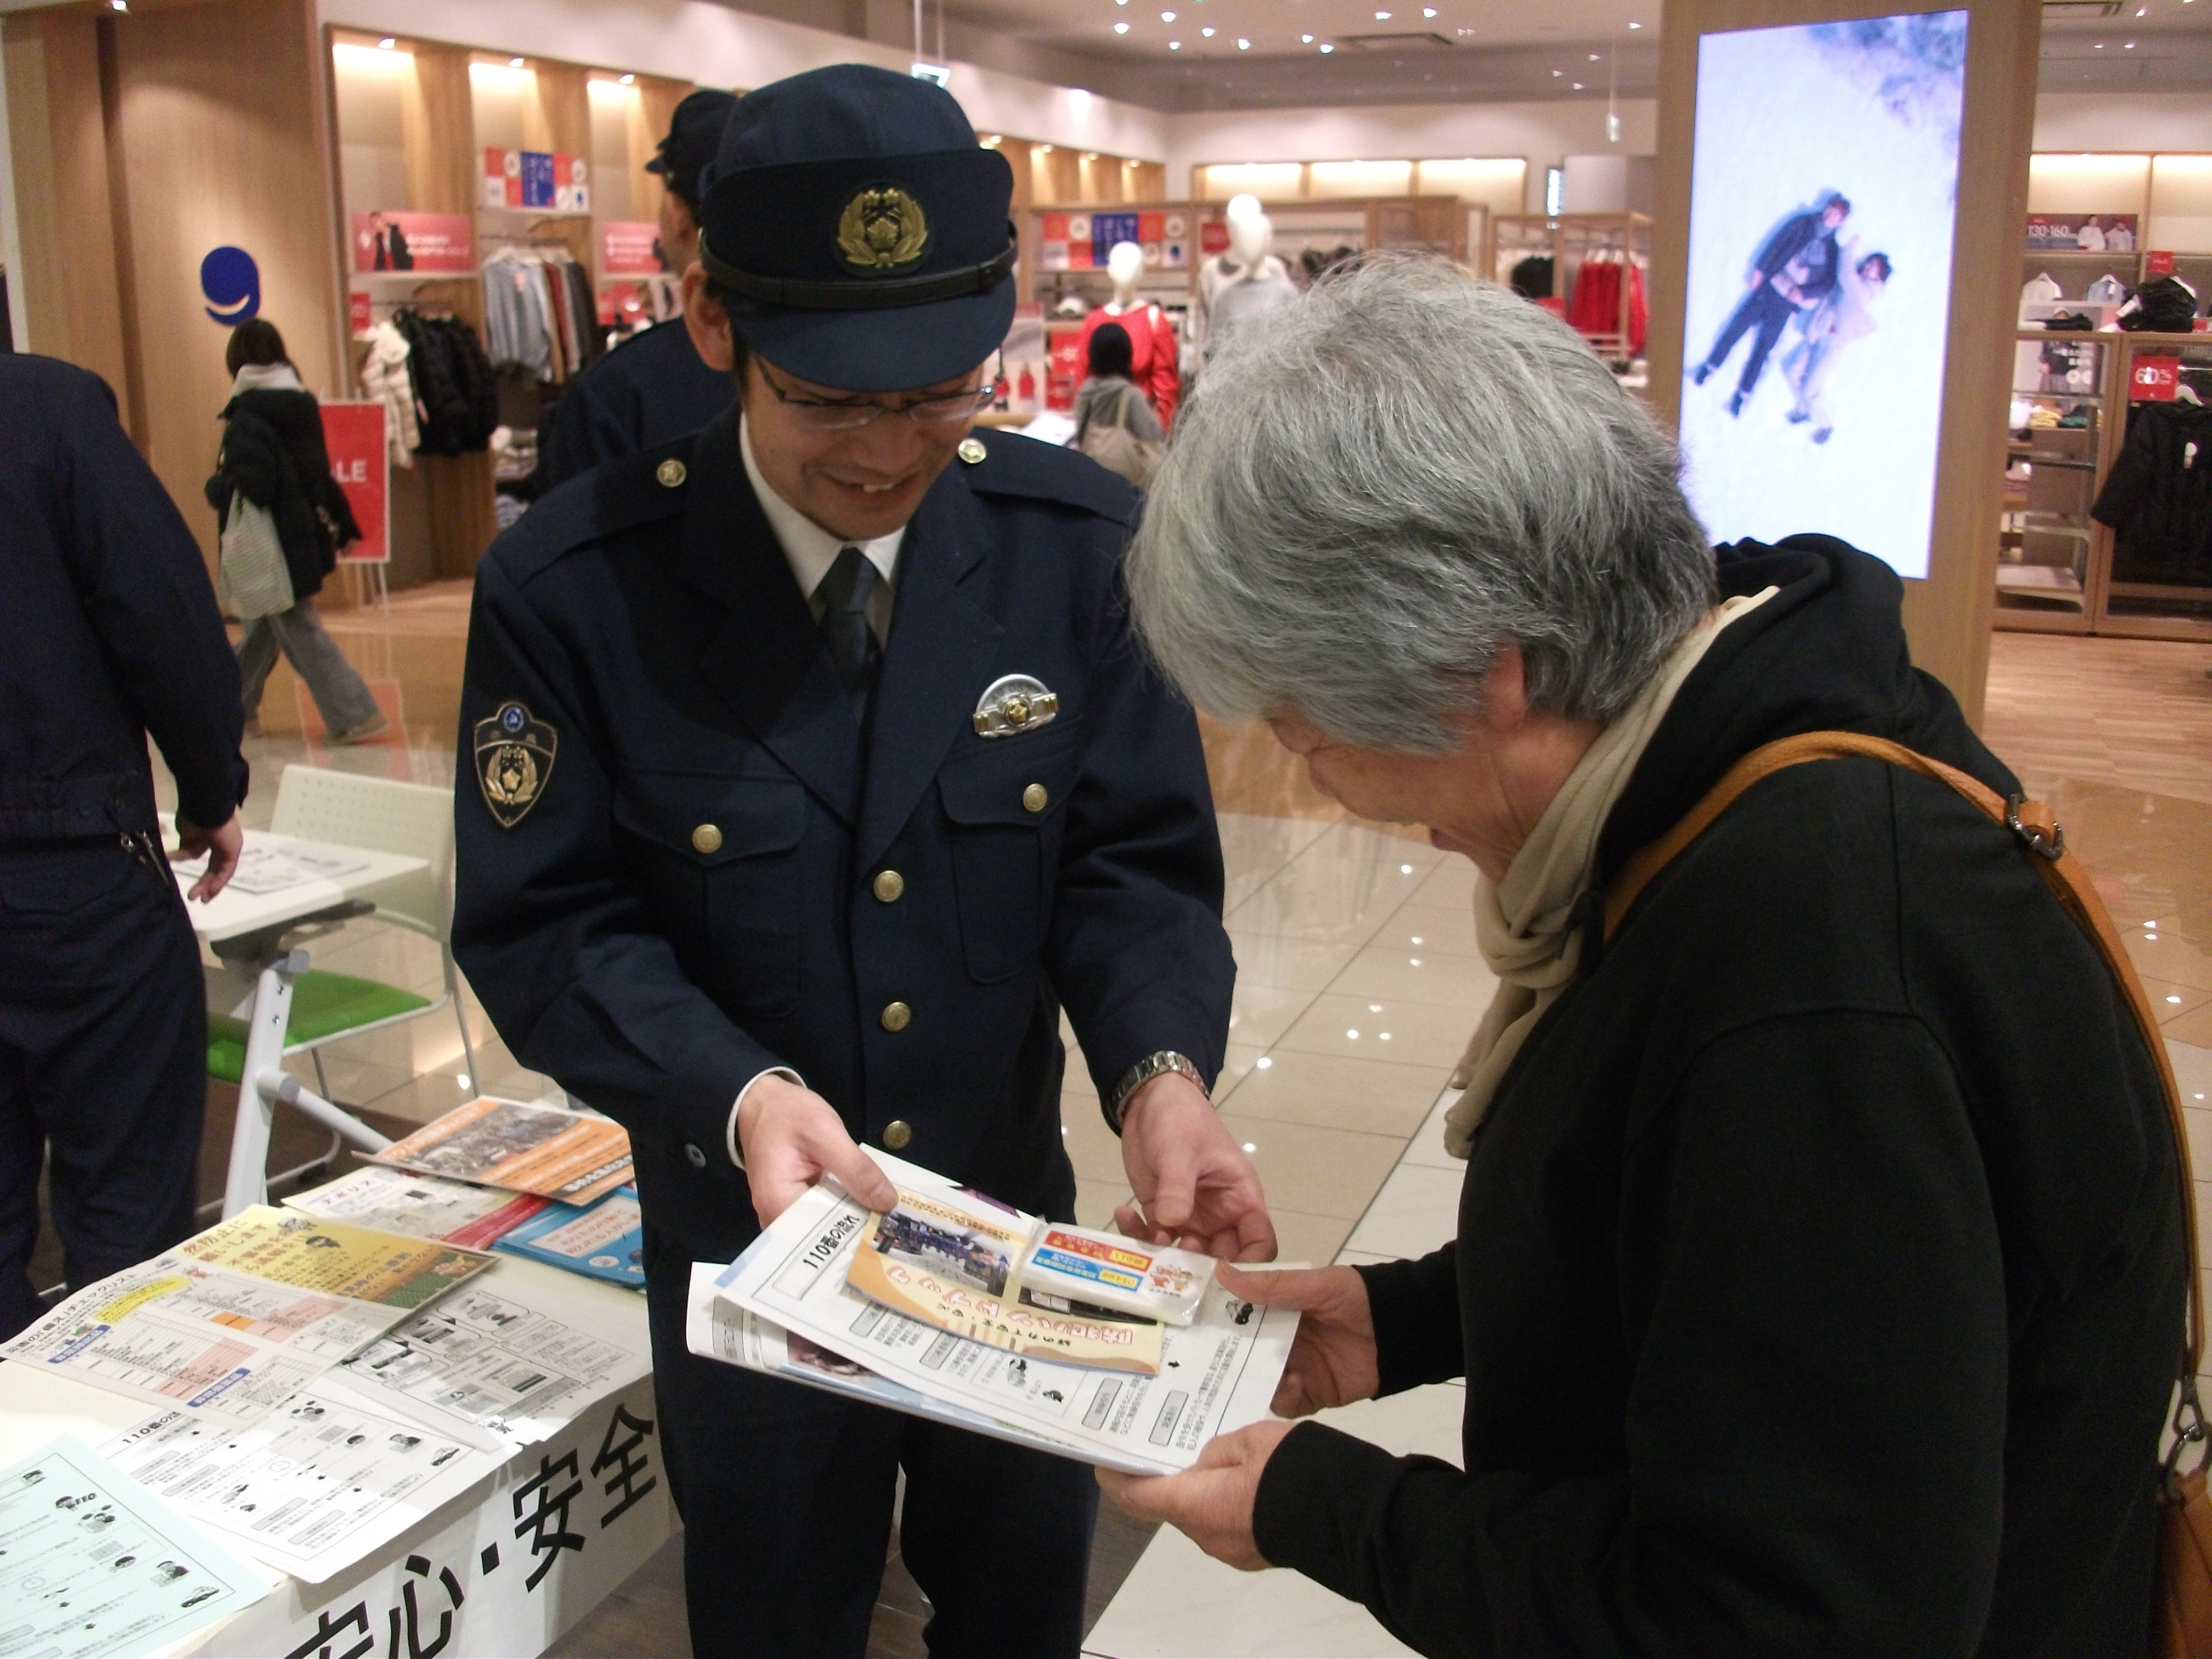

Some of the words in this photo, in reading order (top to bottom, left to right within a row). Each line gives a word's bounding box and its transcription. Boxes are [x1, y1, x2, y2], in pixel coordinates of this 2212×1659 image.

[332, 458, 367, 483] LE
[803, 1214, 860, 1269] 110番の流れ
[886, 1265, 1133, 1345] 防犯ハンドブック
